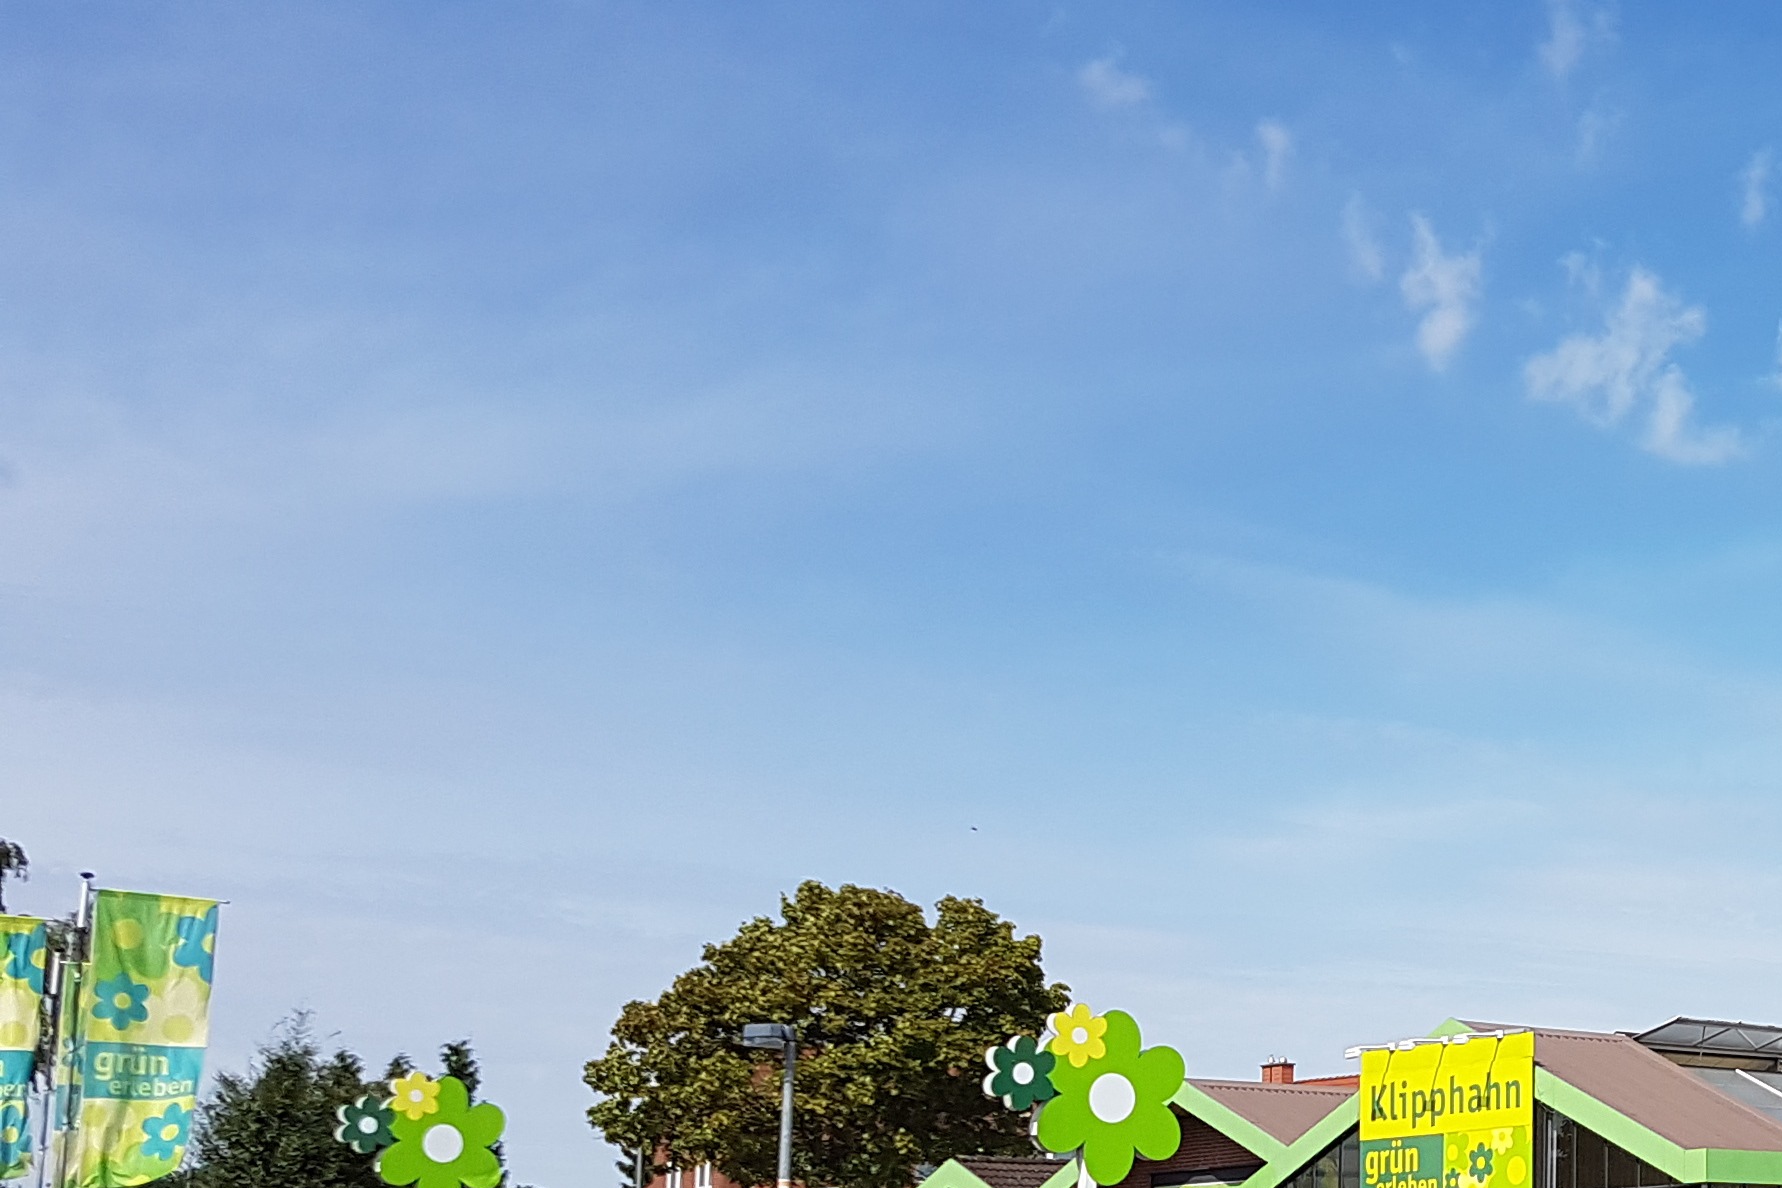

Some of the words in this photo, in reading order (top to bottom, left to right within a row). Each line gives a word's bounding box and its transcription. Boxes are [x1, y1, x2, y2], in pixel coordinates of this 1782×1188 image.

[94, 1045, 169, 1080] grün
[109, 1077, 193, 1097] erleben
[1371, 1071, 1521, 1129] Klipphahn
[1365, 1139, 1419, 1184] grün
